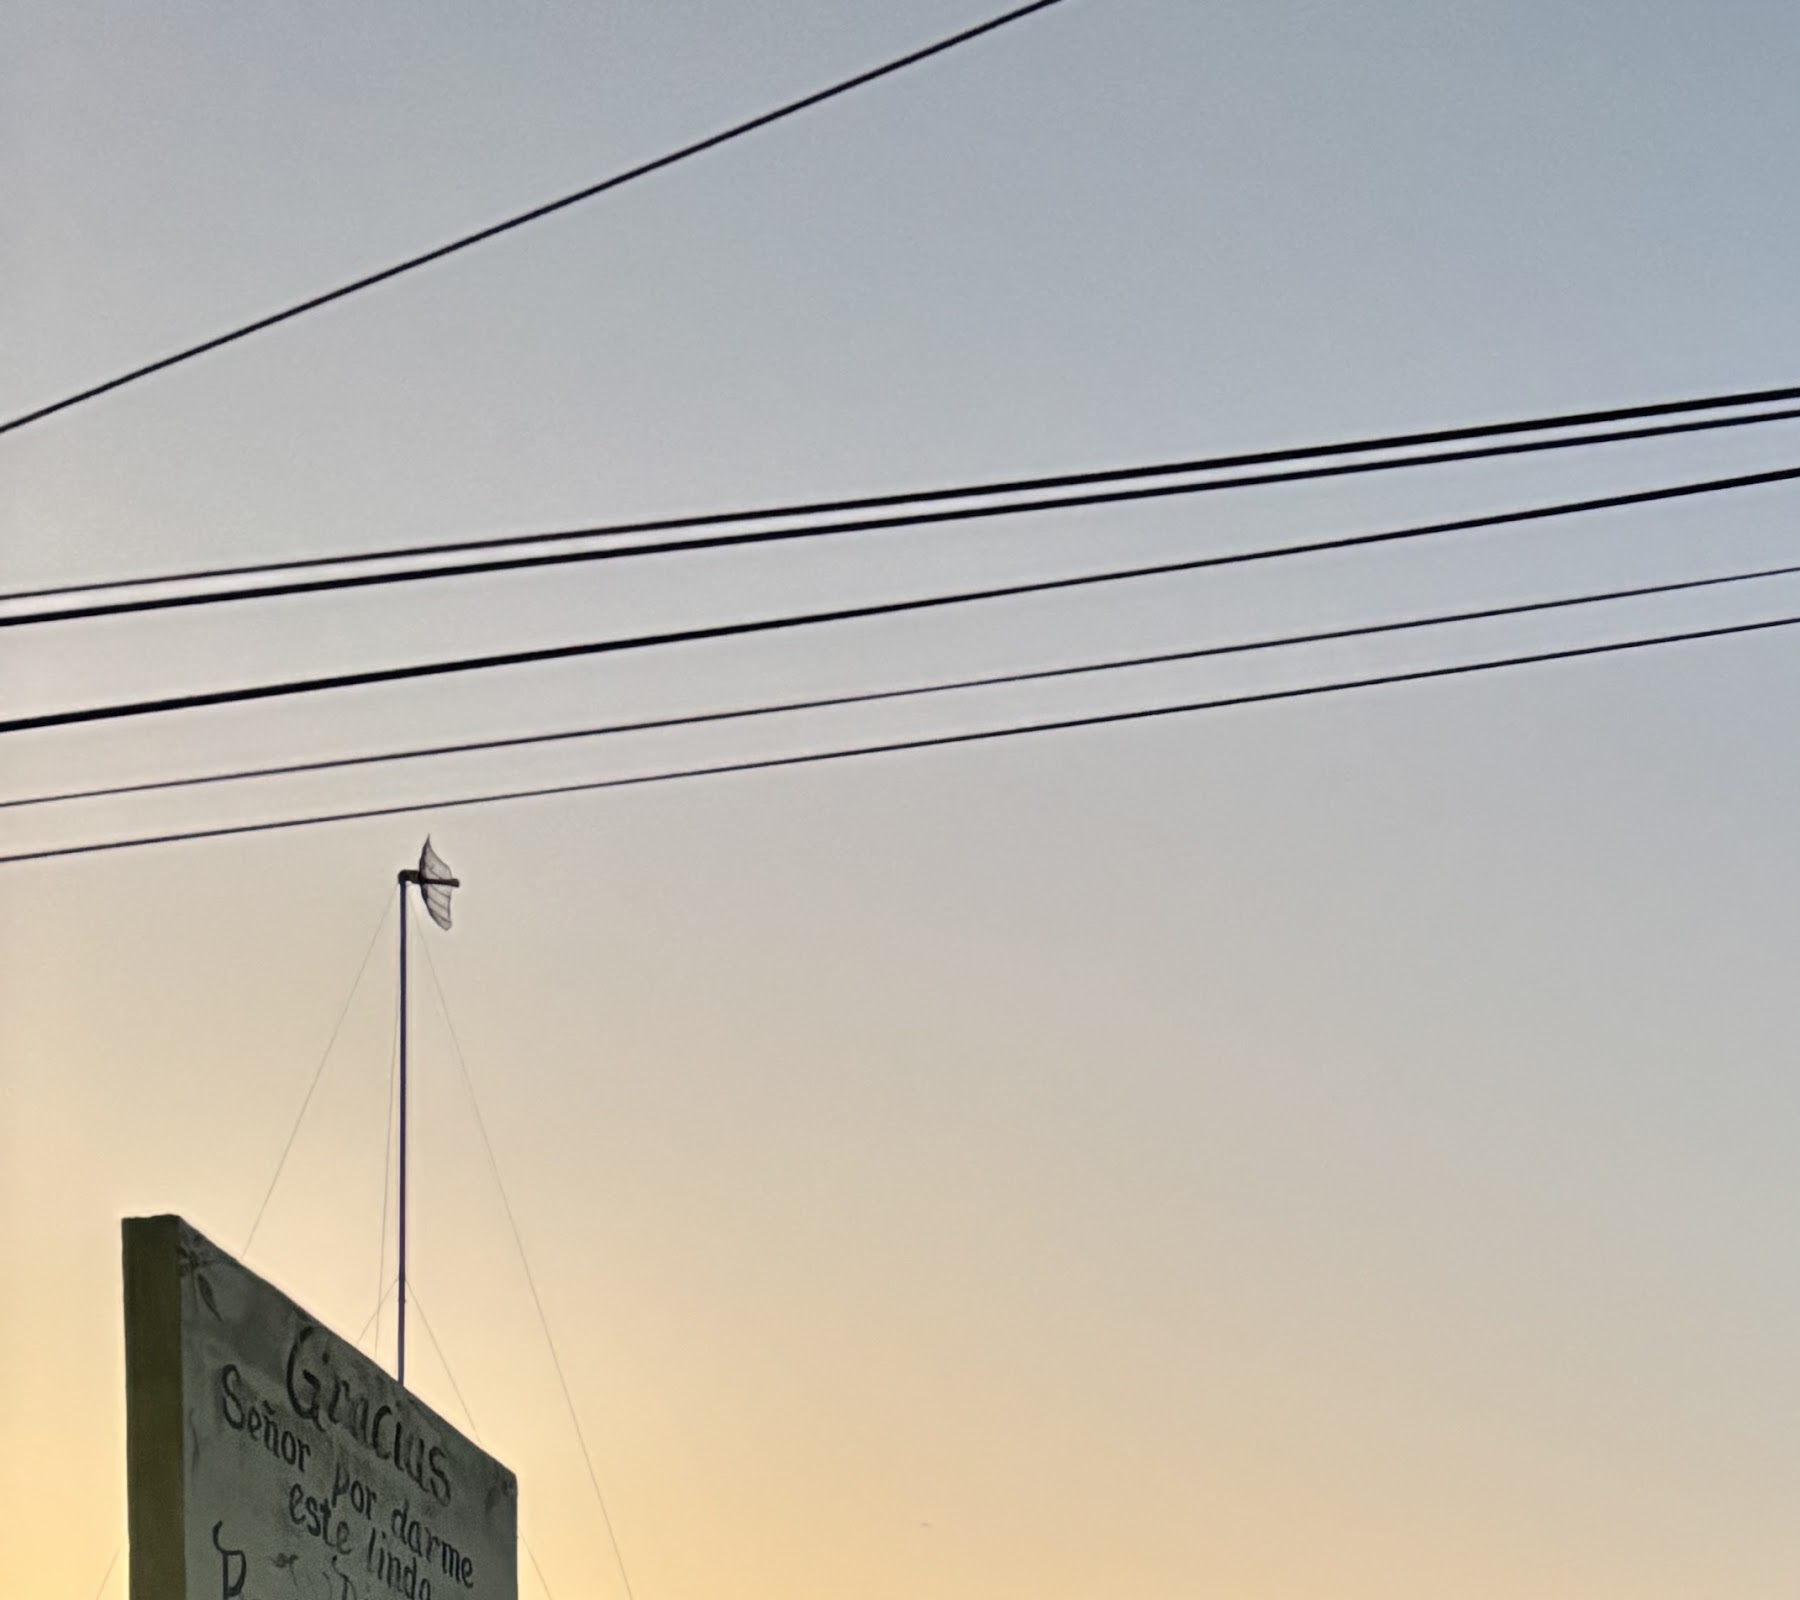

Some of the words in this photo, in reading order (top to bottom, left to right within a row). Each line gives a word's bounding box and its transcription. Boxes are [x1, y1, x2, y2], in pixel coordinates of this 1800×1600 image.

[221, 1363, 312, 1473] Señor
[331, 1457, 377, 1520] por
[391, 1498, 474, 1589] darme
[286, 1325, 450, 1507] Gracias
[289, 1483, 352, 1555] este
